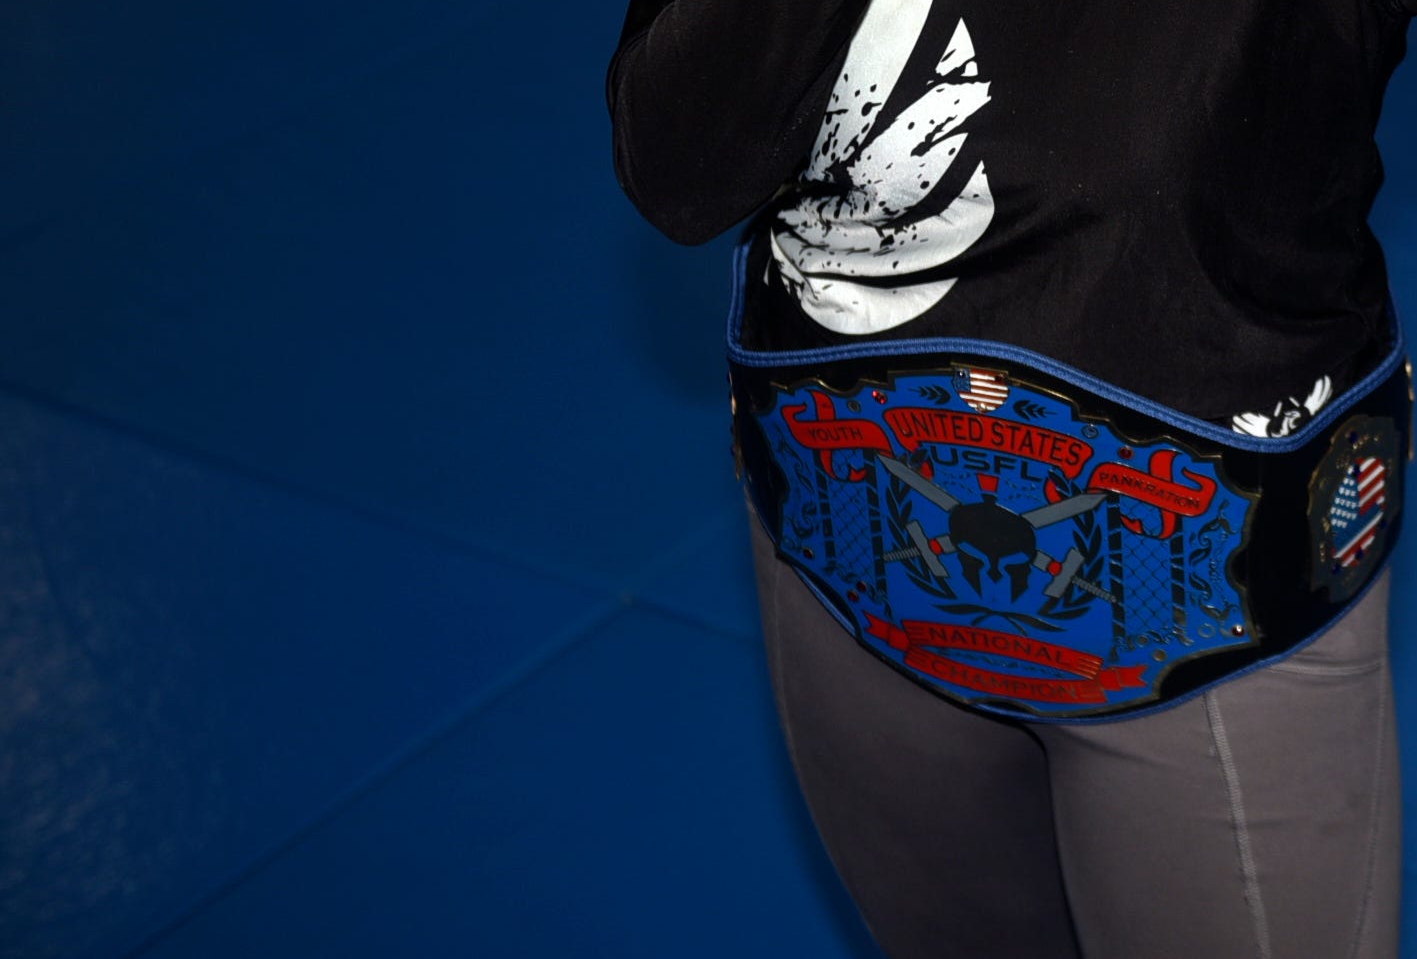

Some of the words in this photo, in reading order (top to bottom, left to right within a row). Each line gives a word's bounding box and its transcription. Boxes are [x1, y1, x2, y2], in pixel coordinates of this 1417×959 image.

[806, 425, 864, 442] YOUTH
[892, 413, 985, 442] UNITED
[991, 423, 1081, 466] STATES
[930, 446, 1043, 482] USFL
[1100, 472, 1199, 508] PANKRATION
[930, 626, 1073, 667] NATIONAL
[931, 659, 1077, 699] CHAMPION
